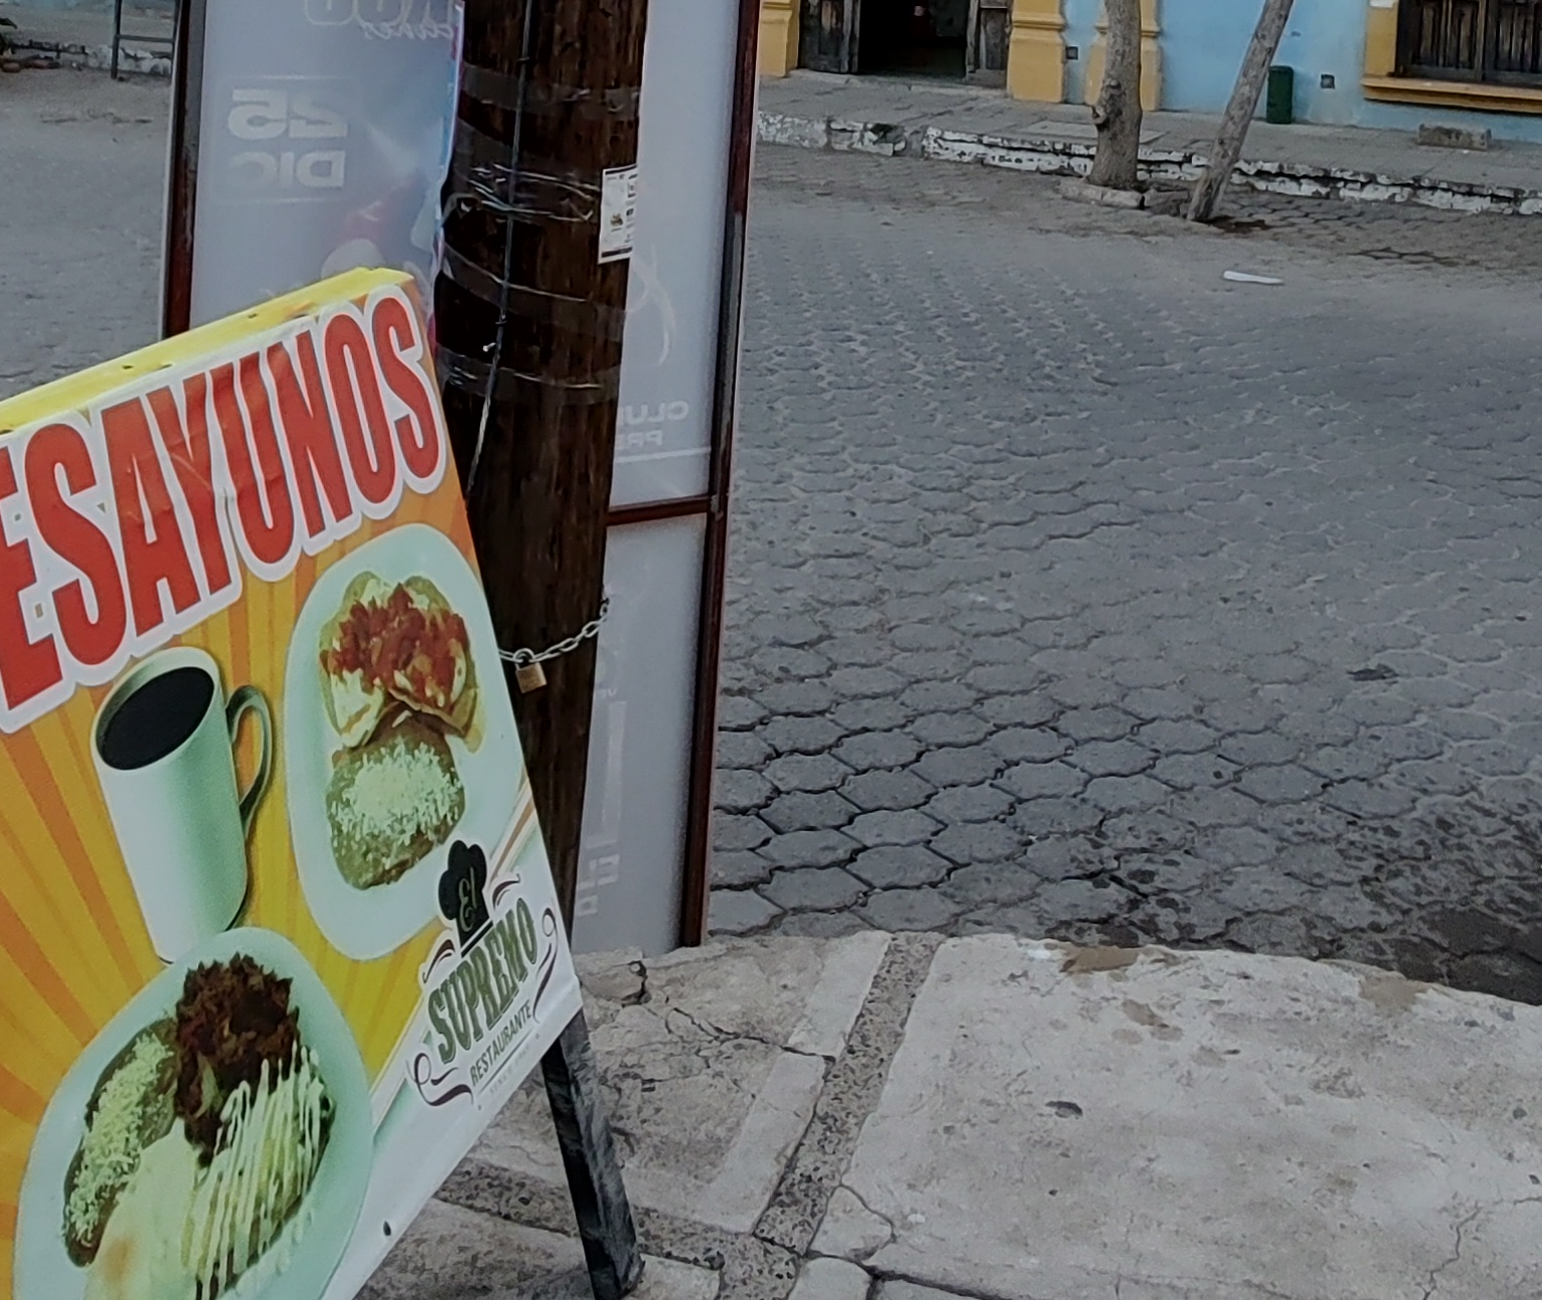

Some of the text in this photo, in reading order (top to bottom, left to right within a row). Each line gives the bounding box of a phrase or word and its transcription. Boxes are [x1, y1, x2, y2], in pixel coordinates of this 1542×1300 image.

[458, 865, 478, 933] El
[427, 897, 538, 1065] SUPREMO
[469, 999, 533, 1088] RESTAURANTE
